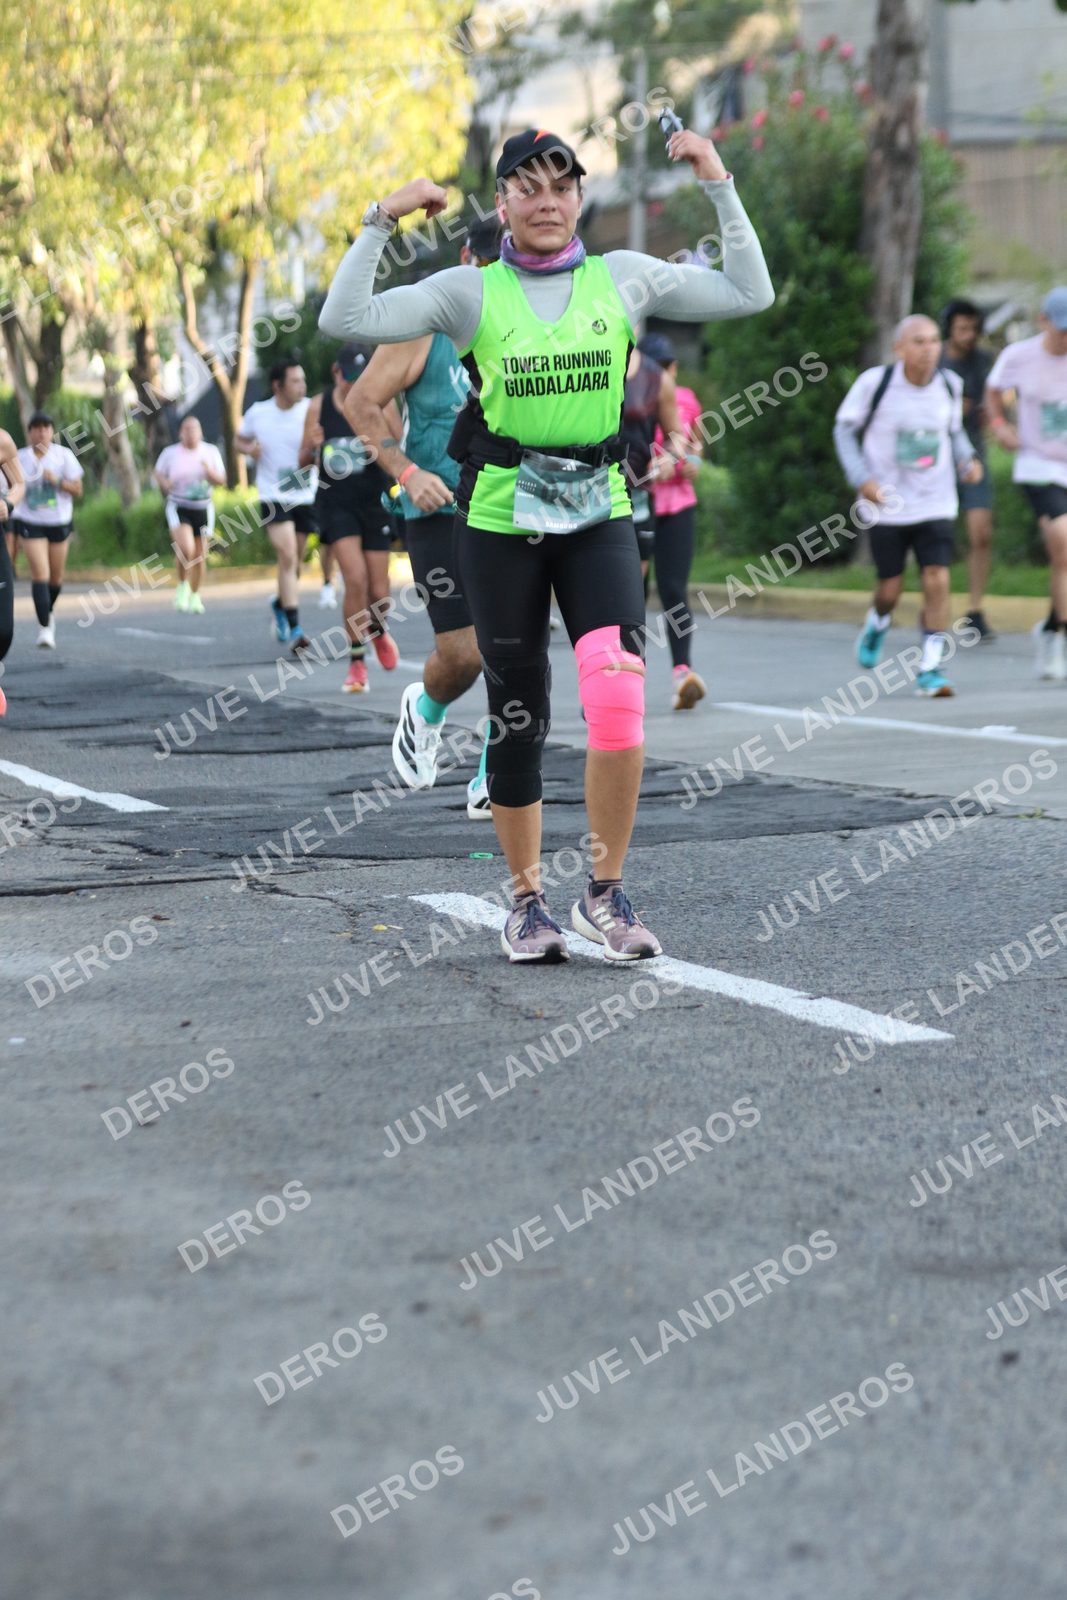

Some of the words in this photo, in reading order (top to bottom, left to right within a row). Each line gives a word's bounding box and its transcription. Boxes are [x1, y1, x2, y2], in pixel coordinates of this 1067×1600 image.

[502, 355, 550, 375] TOWER
[553, 349, 612, 371] RUNNING
[504, 370, 609, 398] GUADALAJARA
